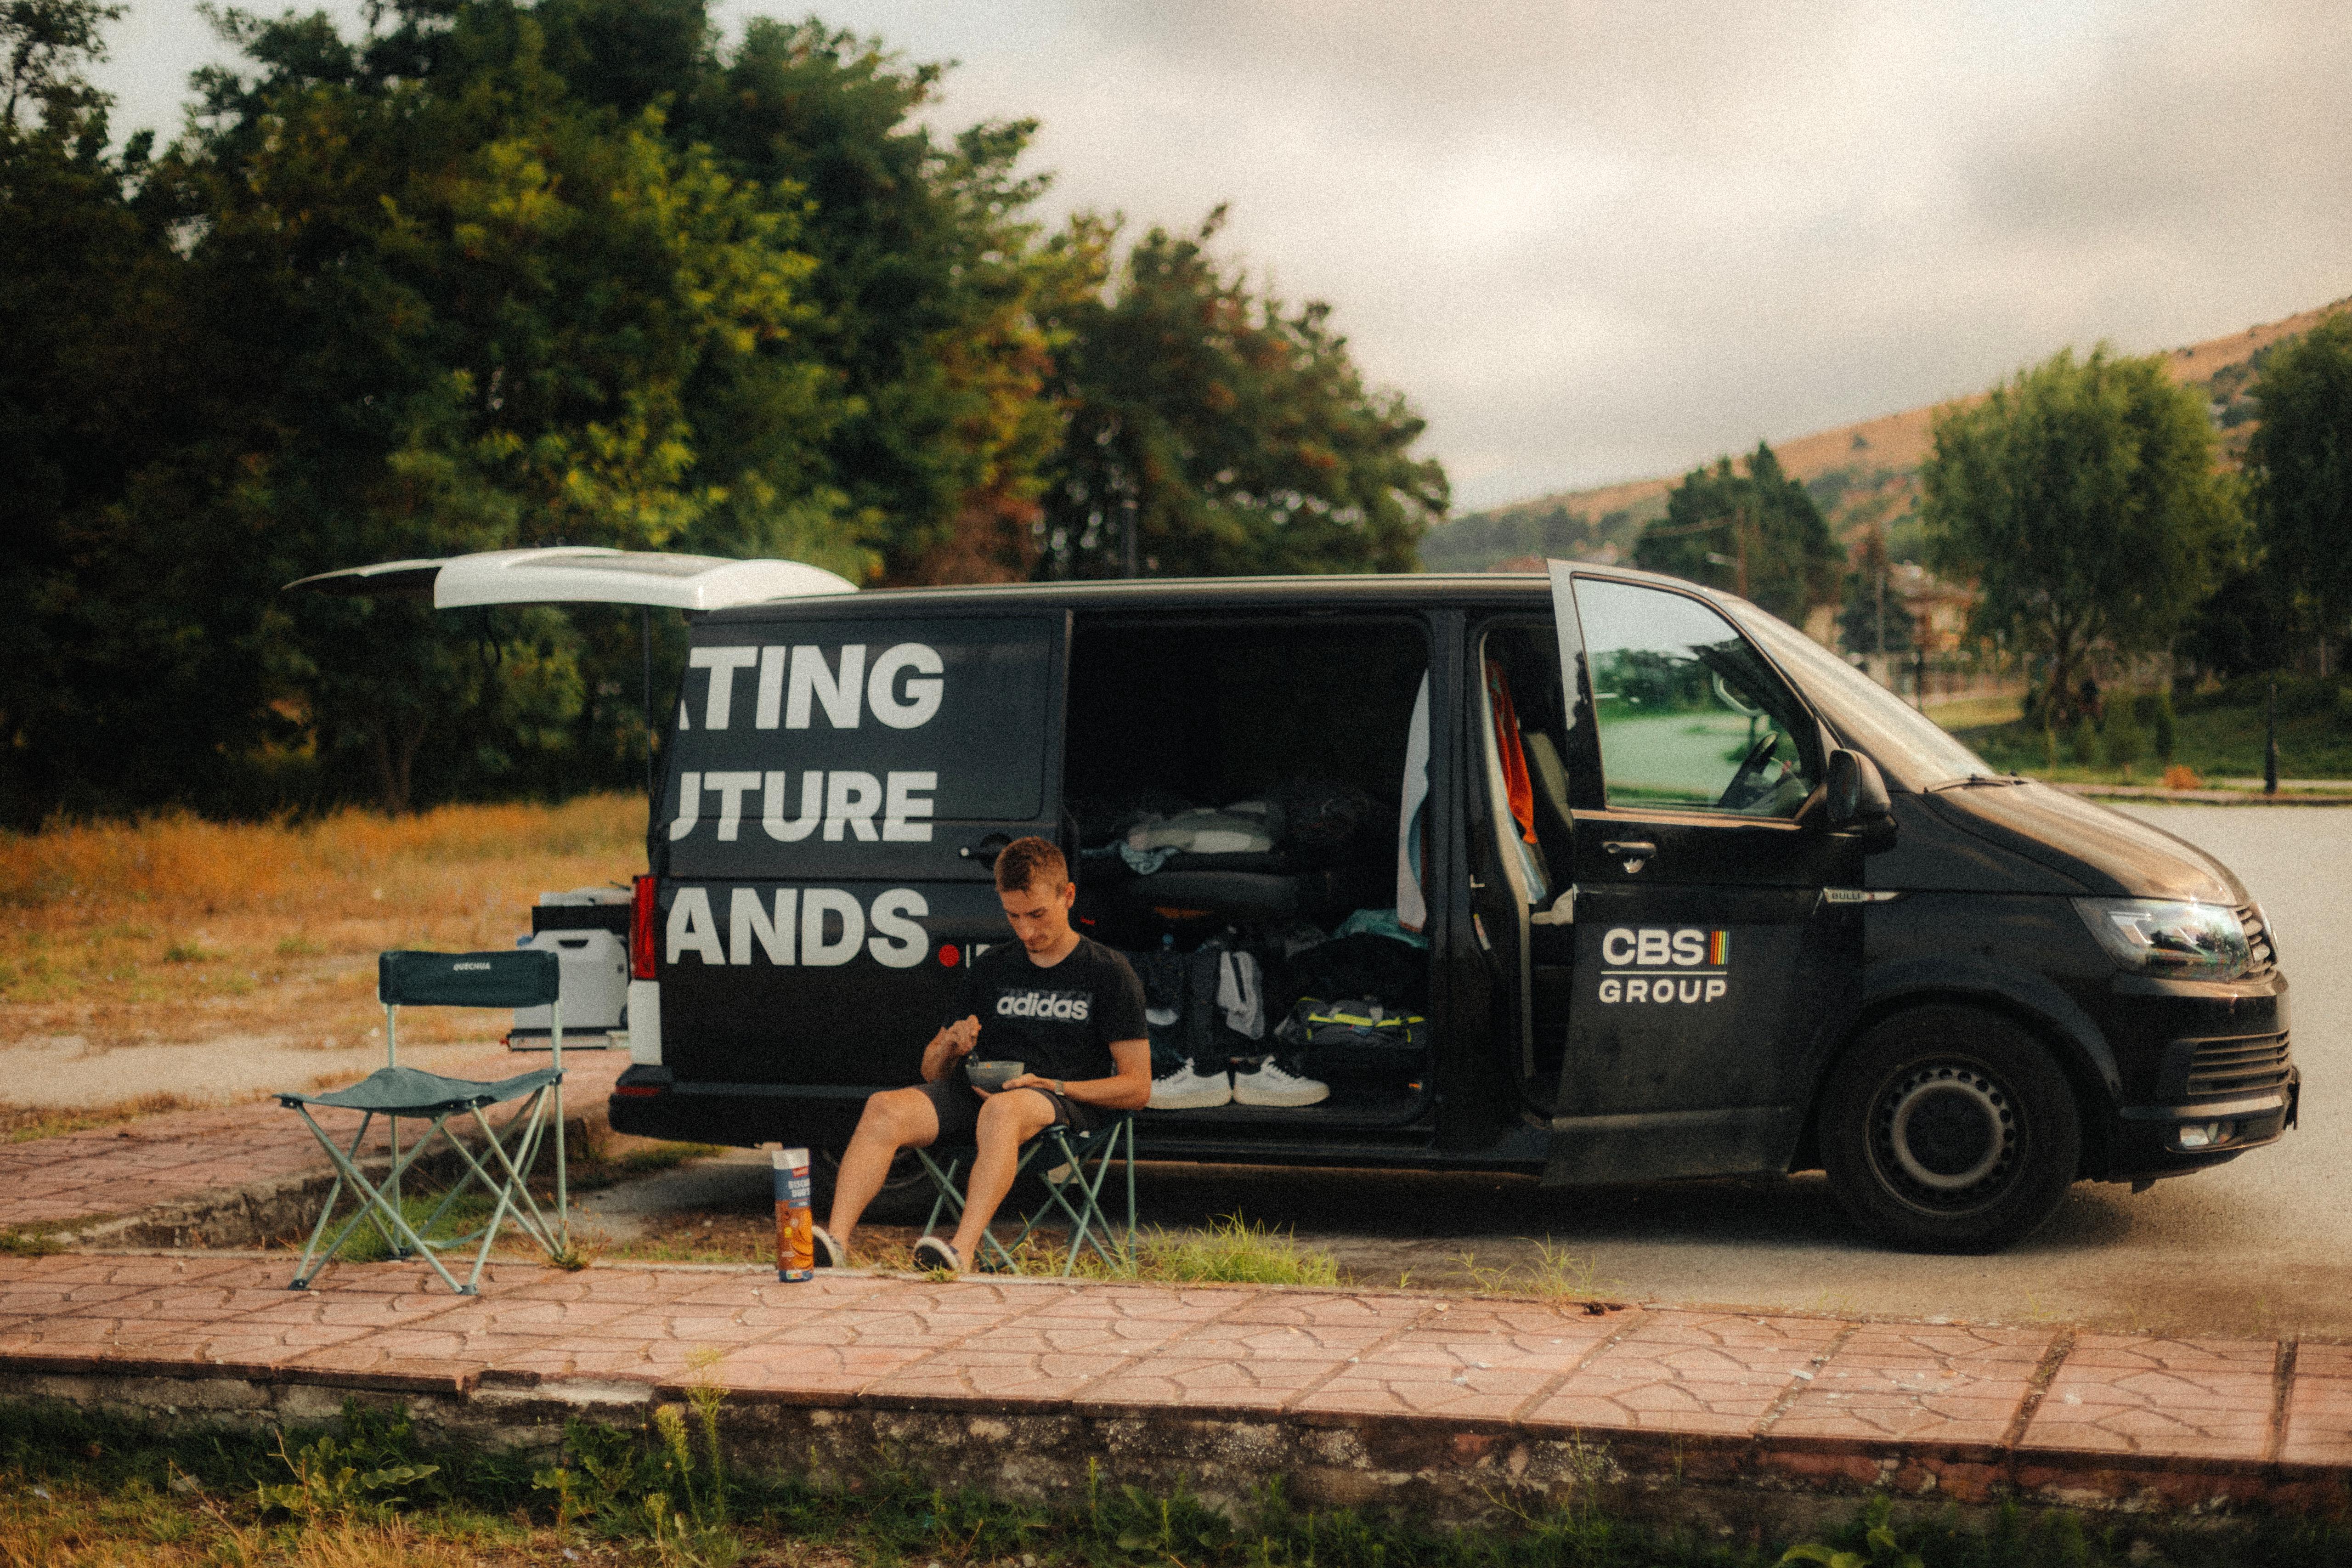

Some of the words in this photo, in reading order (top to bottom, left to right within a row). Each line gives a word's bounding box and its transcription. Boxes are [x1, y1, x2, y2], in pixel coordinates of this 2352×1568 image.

[679, 643, 944, 730] TING
[1602, 928, 1705, 965] CBS
[997, 992, 1089, 1020] adidas
[1599, 979, 1727, 1003] GROUP
